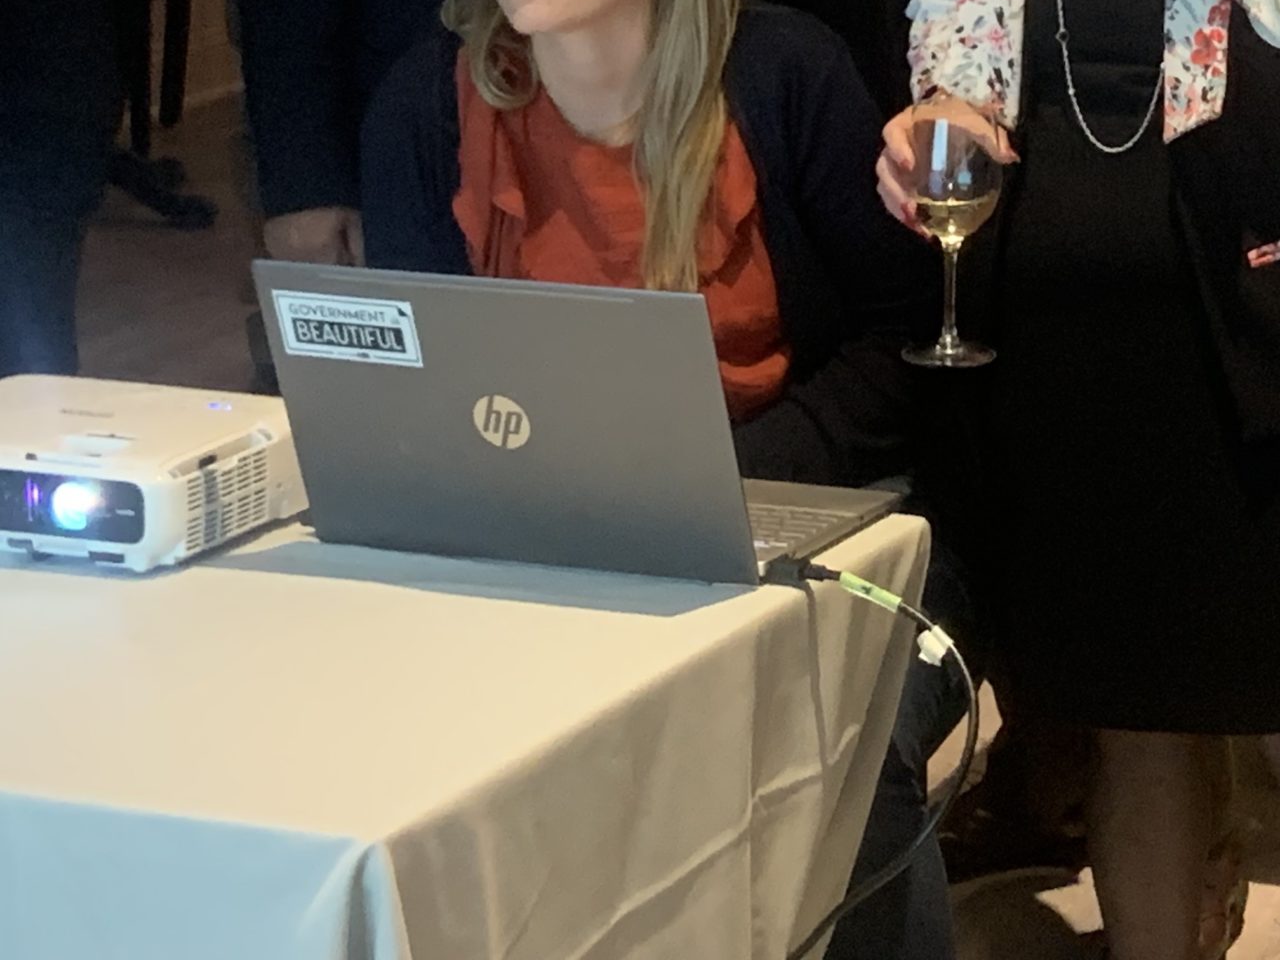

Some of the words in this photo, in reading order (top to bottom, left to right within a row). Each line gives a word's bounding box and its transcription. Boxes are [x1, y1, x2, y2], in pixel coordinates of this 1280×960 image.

[288, 302, 386, 322] GOVERNMENT
[295, 319, 404, 351] BEAUTIFUL
[482, 395, 524, 448] hp
